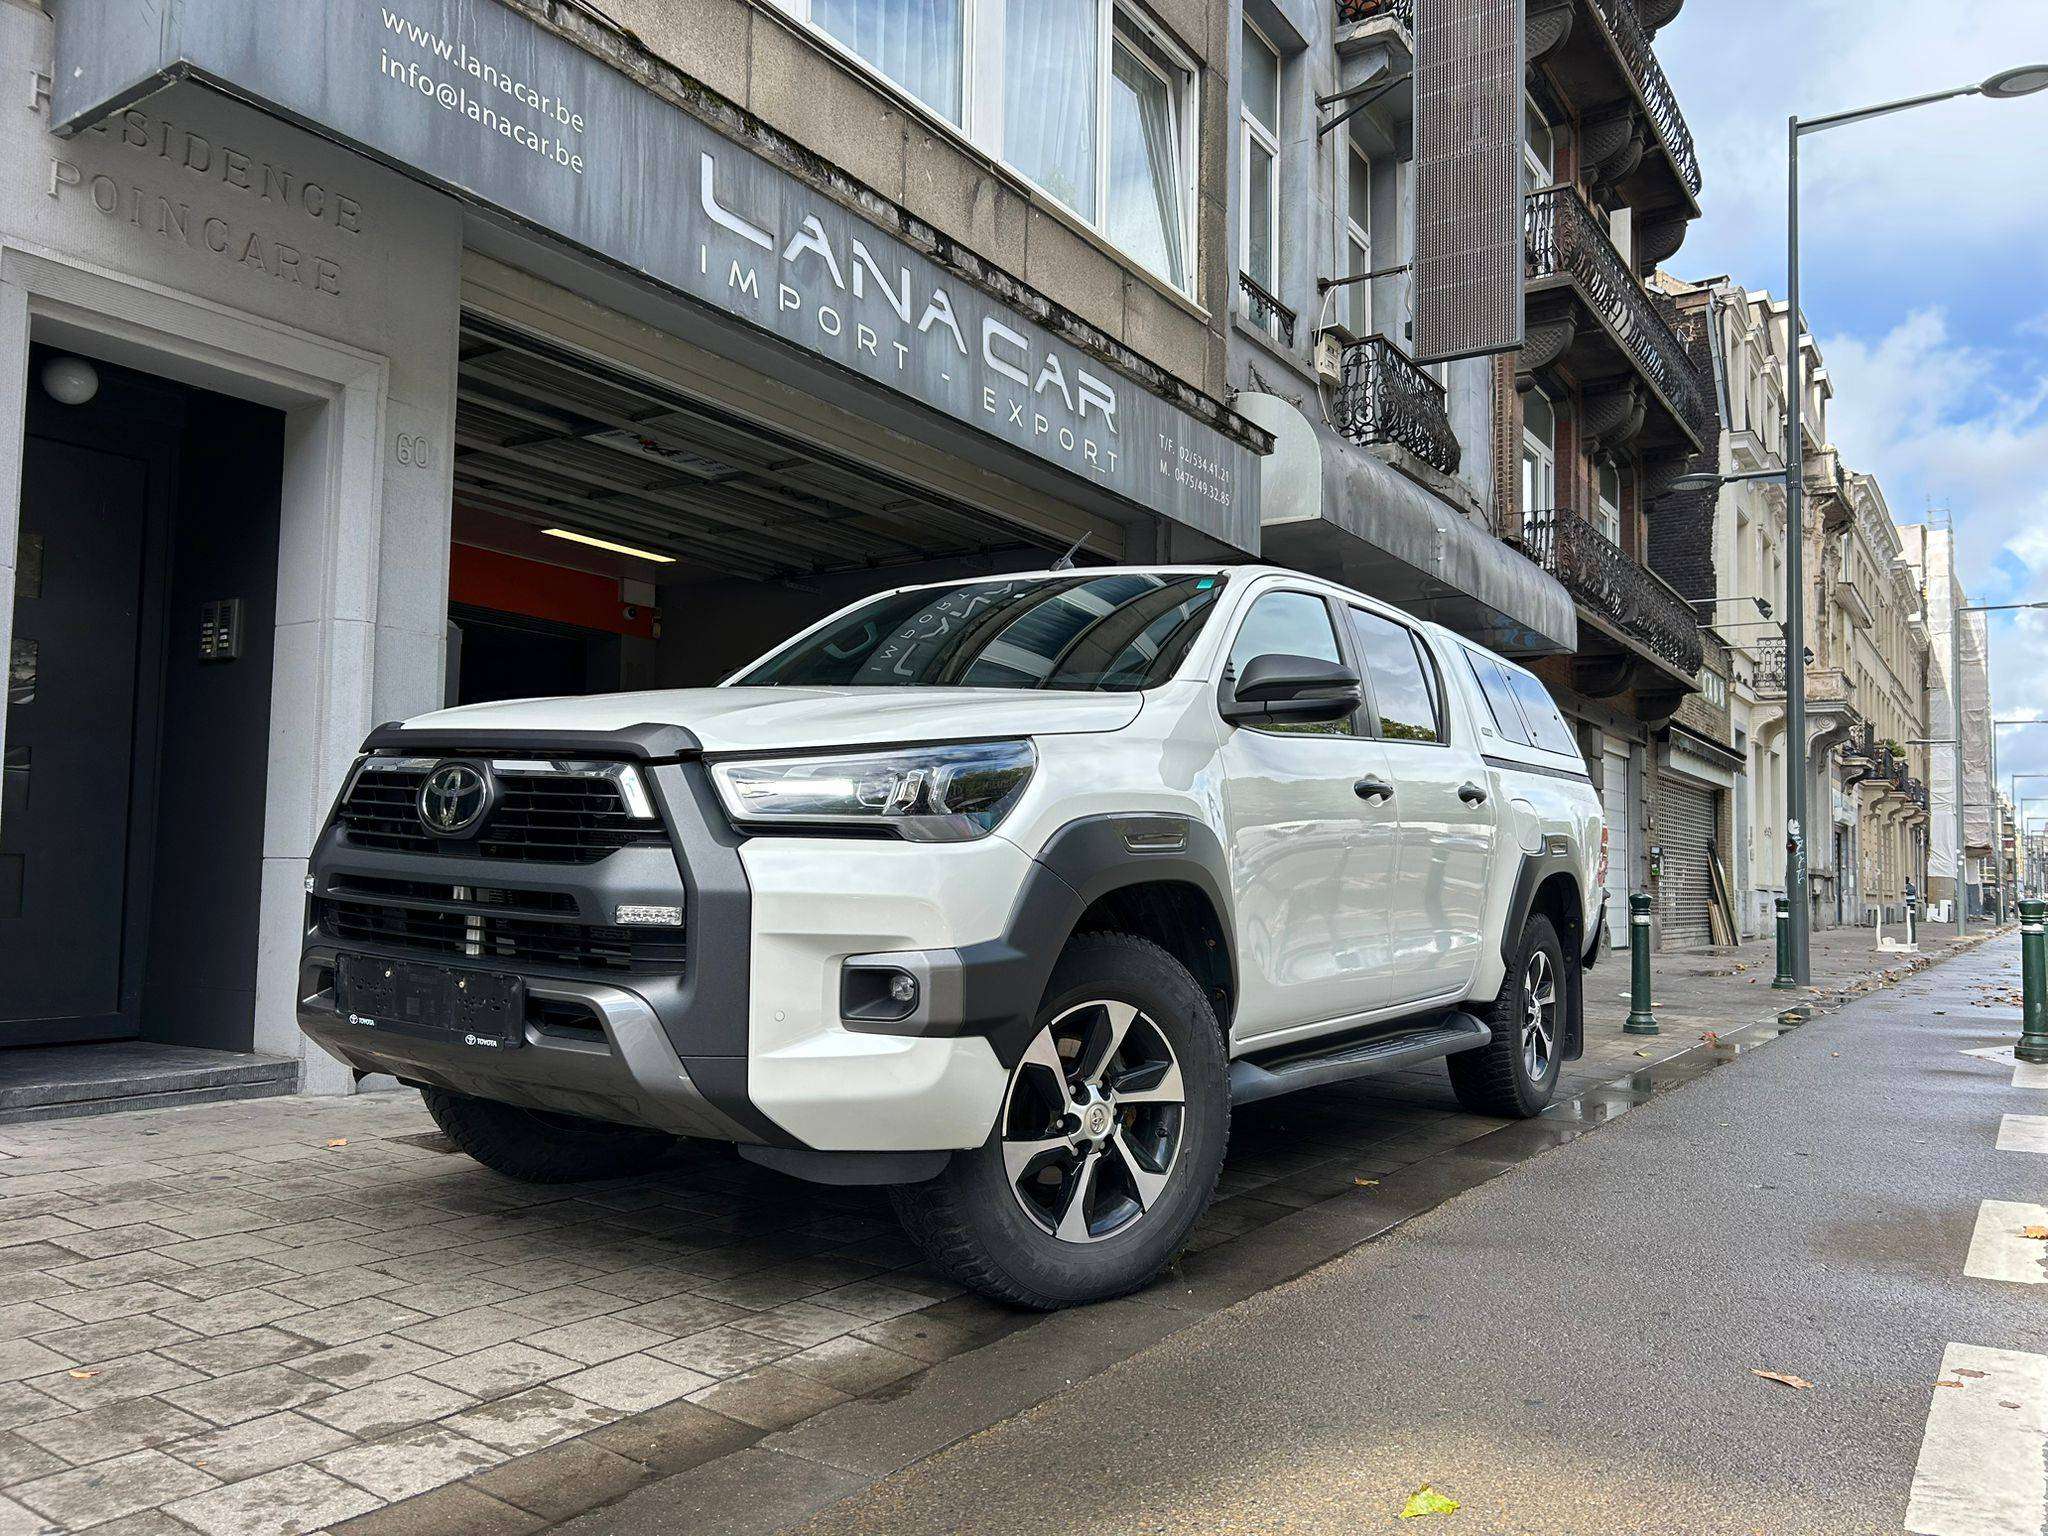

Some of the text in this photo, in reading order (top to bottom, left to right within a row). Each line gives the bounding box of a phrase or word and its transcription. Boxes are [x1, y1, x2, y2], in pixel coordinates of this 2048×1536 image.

[381, 7, 584, 133] www.lanacar.be
[381, 48, 584, 174] info@lanacar.be
[47, 155, 343, 297] POINCARE
[701, 244, 909, 370] IMPORT
[983, 386, 1118, 473] EXPORT
[396, 433, 429, 469] 60
[1179, 446, 1230, 483] 02/534.41.21
[1160, 459, 1230, 506] M. 0475/49.32.85
[359, 1017, 375, 1027] TOYOTA
[477, 1037, 498, 1048] TOYOTA
